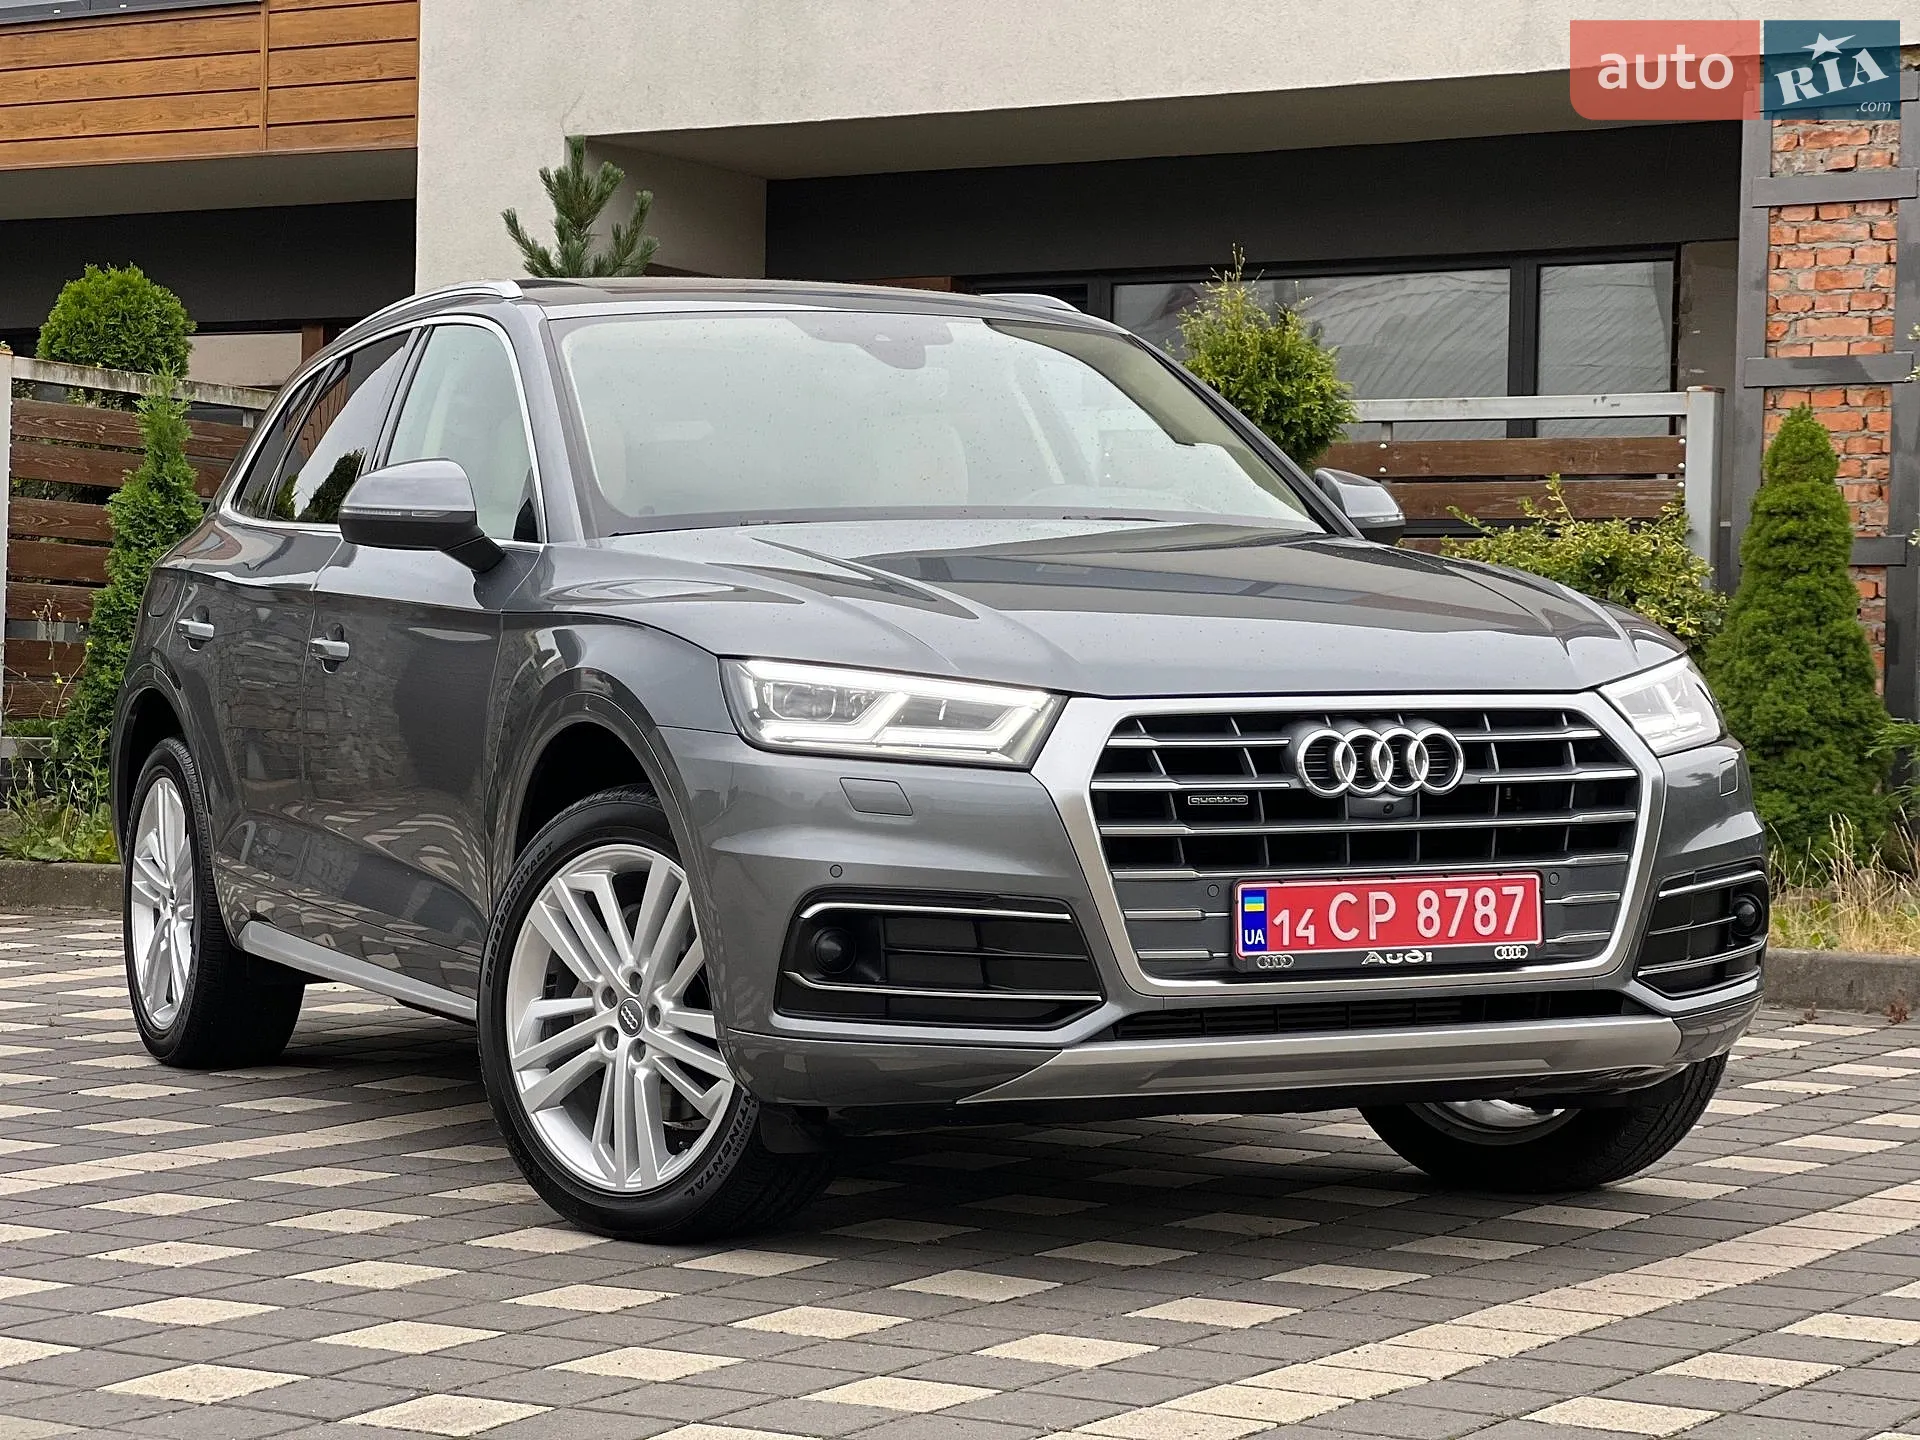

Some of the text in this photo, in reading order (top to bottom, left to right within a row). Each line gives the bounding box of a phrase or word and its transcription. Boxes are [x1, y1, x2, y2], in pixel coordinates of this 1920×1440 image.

[1190, 796, 1247, 806] quattro
[1272, 885, 1526, 946] 14 CP 8787
[1244, 928, 1266, 946] UA
[1361, 949, 1433, 965] Audi
[684, 1094, 753, 1197] NTINENTAL
